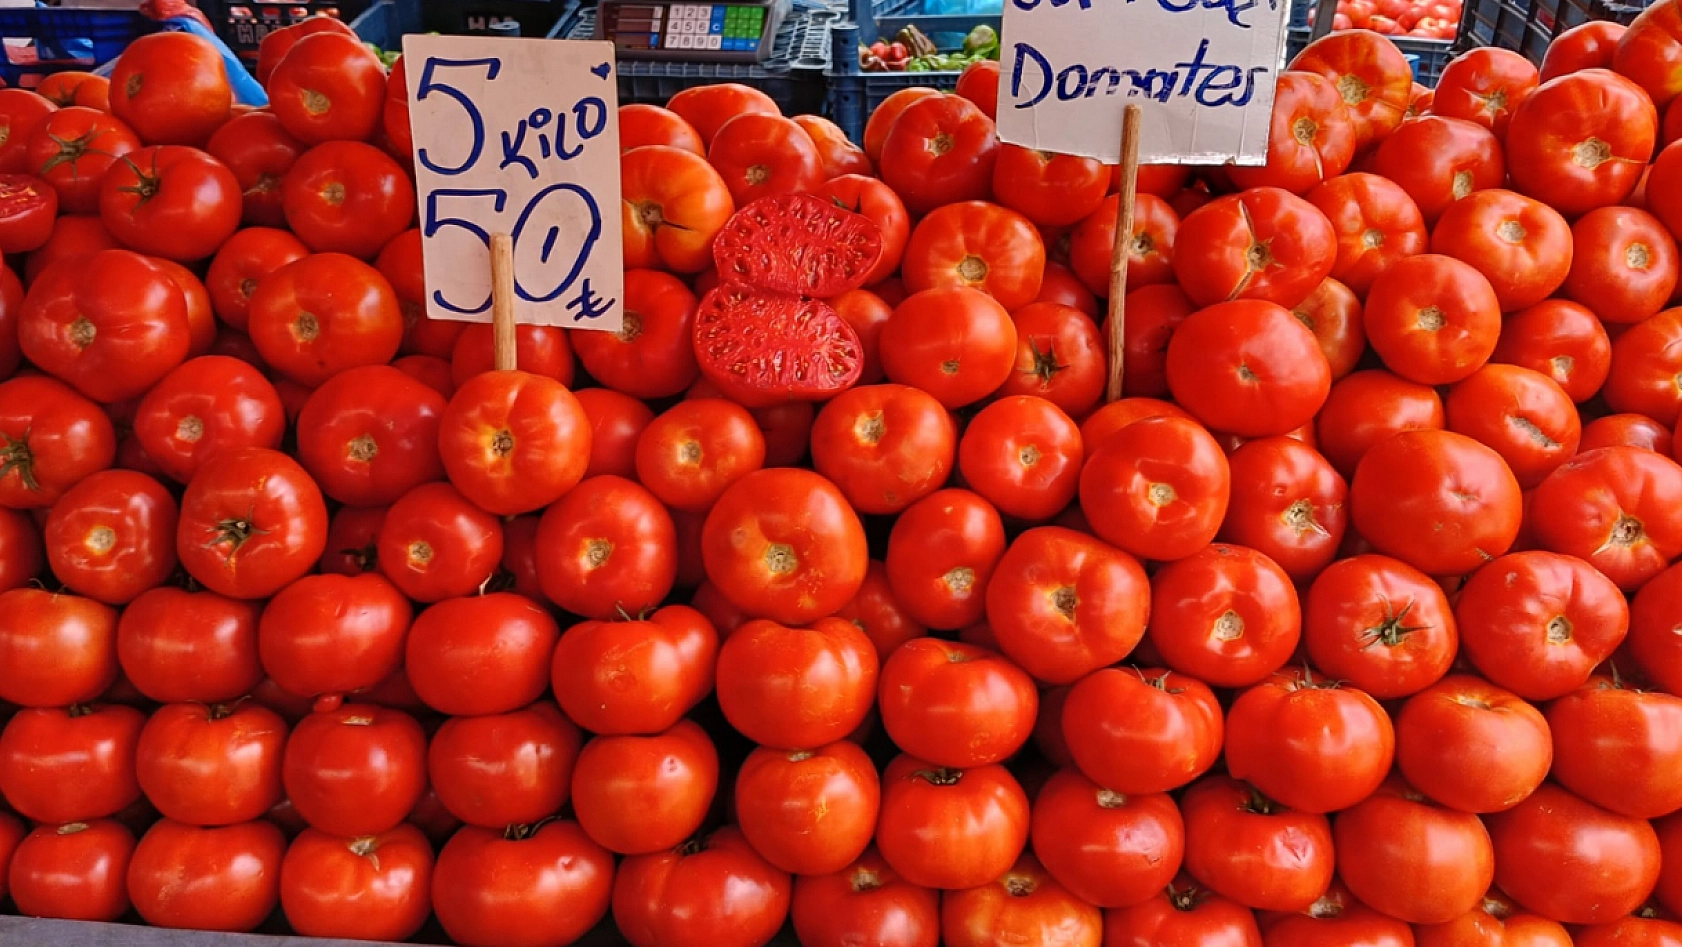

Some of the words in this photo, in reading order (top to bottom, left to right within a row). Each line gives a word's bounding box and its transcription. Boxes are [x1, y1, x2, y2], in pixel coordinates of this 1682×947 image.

[417, 56, 501, 176] 5
[1010, 38, 1269, 110] Domates
[424, 182, 602, 314] 50
